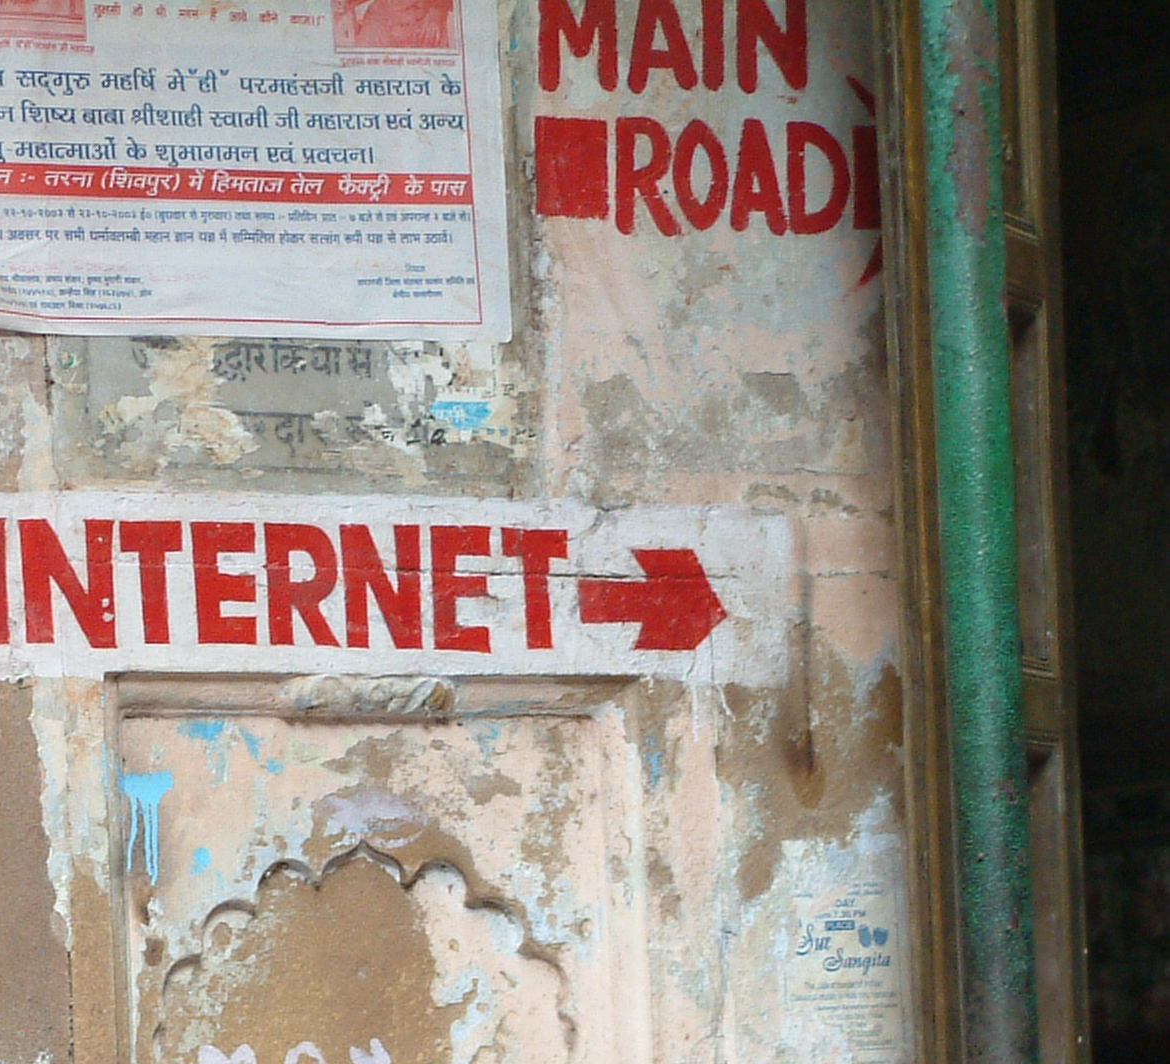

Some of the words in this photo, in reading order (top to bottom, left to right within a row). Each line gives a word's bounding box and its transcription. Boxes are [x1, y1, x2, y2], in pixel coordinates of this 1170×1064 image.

[538, 0, 808, 94] MAIN
[101, 68, 156, 91] महर्षि
[355, 78, 430, 96] महाराज
[441, 74, 461, 96] के
[21, 100, 76, 124] शिष्य
[82, 107, 125, 125] बाबा
[131, 103, 204, 128] श्रीशाही
[209, 106, 268, 129] स्वामी
[274, 106, 299, 129] जी
[306, 112, 381, 130] महाराज
[386, 109, 414, 130] एवं
[418, 113, 464, 131] अन्य
[126, 137, 146, 160] के
[155, 144, 259, 166] शुभागमन
[266, 142, 296, 163] एवं
[44, 170, 93, 188] तरना
[101, 167, 181, 196] (शिवपुर)
[188, 170, 204, 191] में
[212, 171, 284, 194] हिमताज
[289, 173, 325, 195] तेल
[404, 174, 425, 196] के
[430, 180, 466, 196] पास
[615, 116, 851, 237] ROAD
